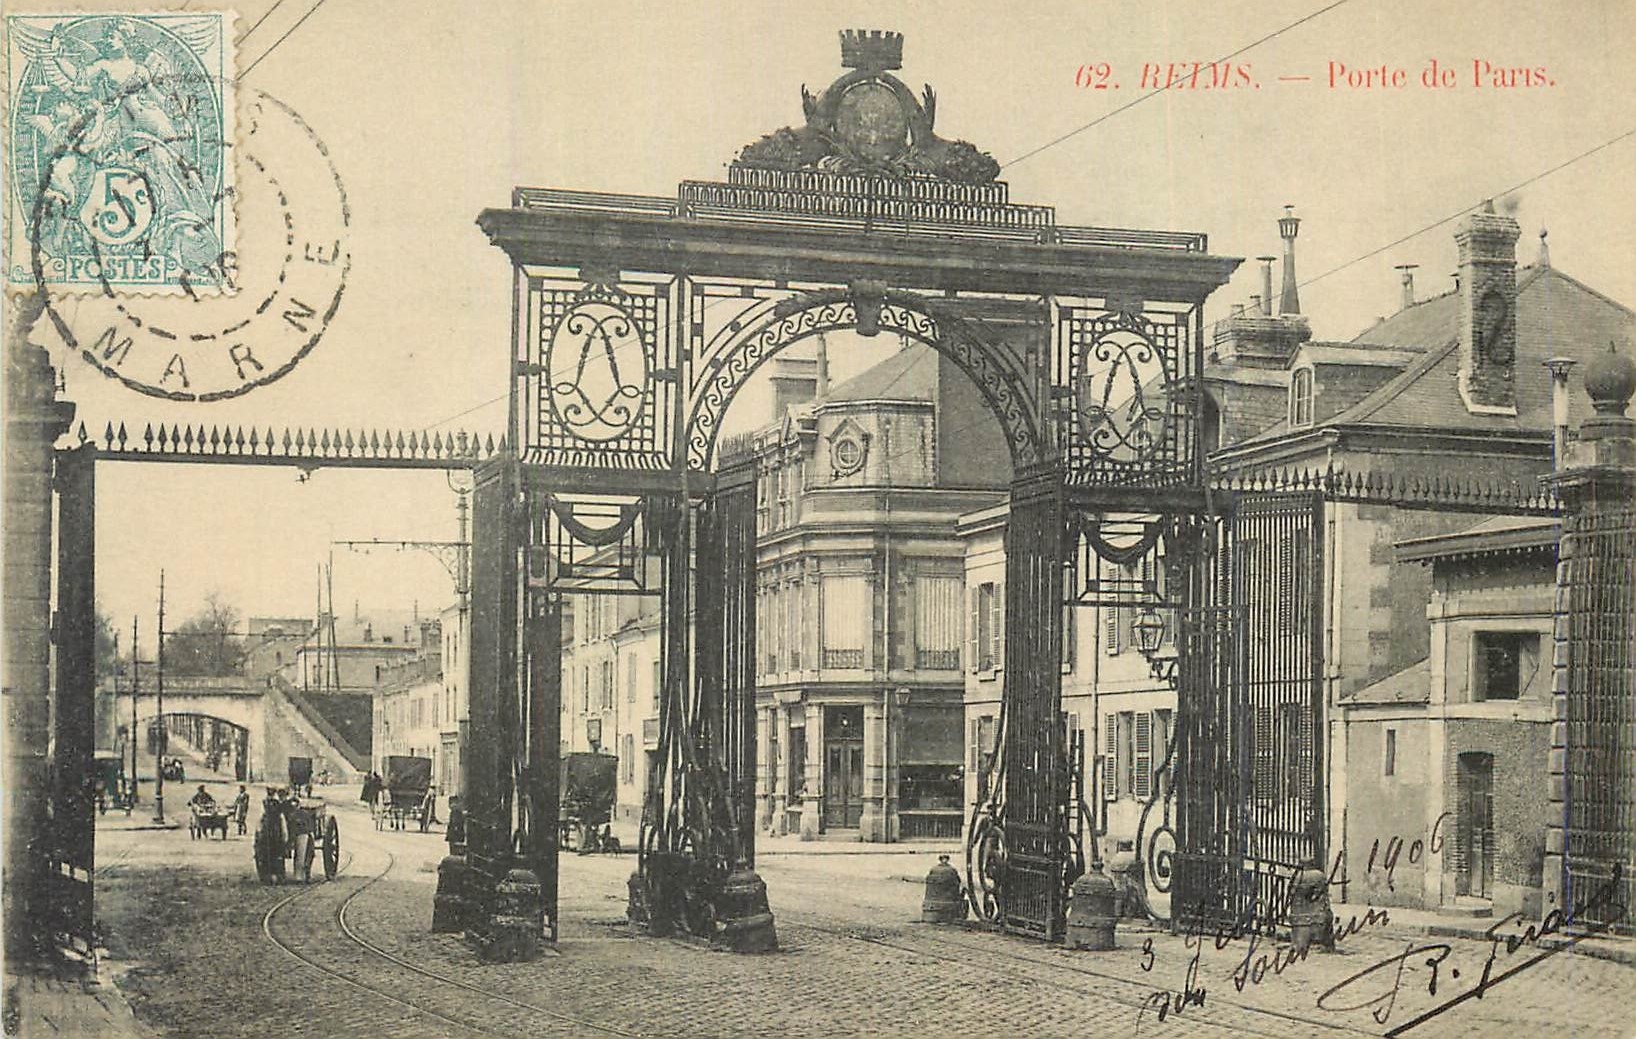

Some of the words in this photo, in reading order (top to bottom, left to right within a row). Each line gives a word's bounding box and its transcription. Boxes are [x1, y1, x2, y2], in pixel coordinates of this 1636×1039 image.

[69, 256, 162, 281] POSTES
[93, 240, 341, 388] MARNE
[1367, 811, 1452, 892] 1906
